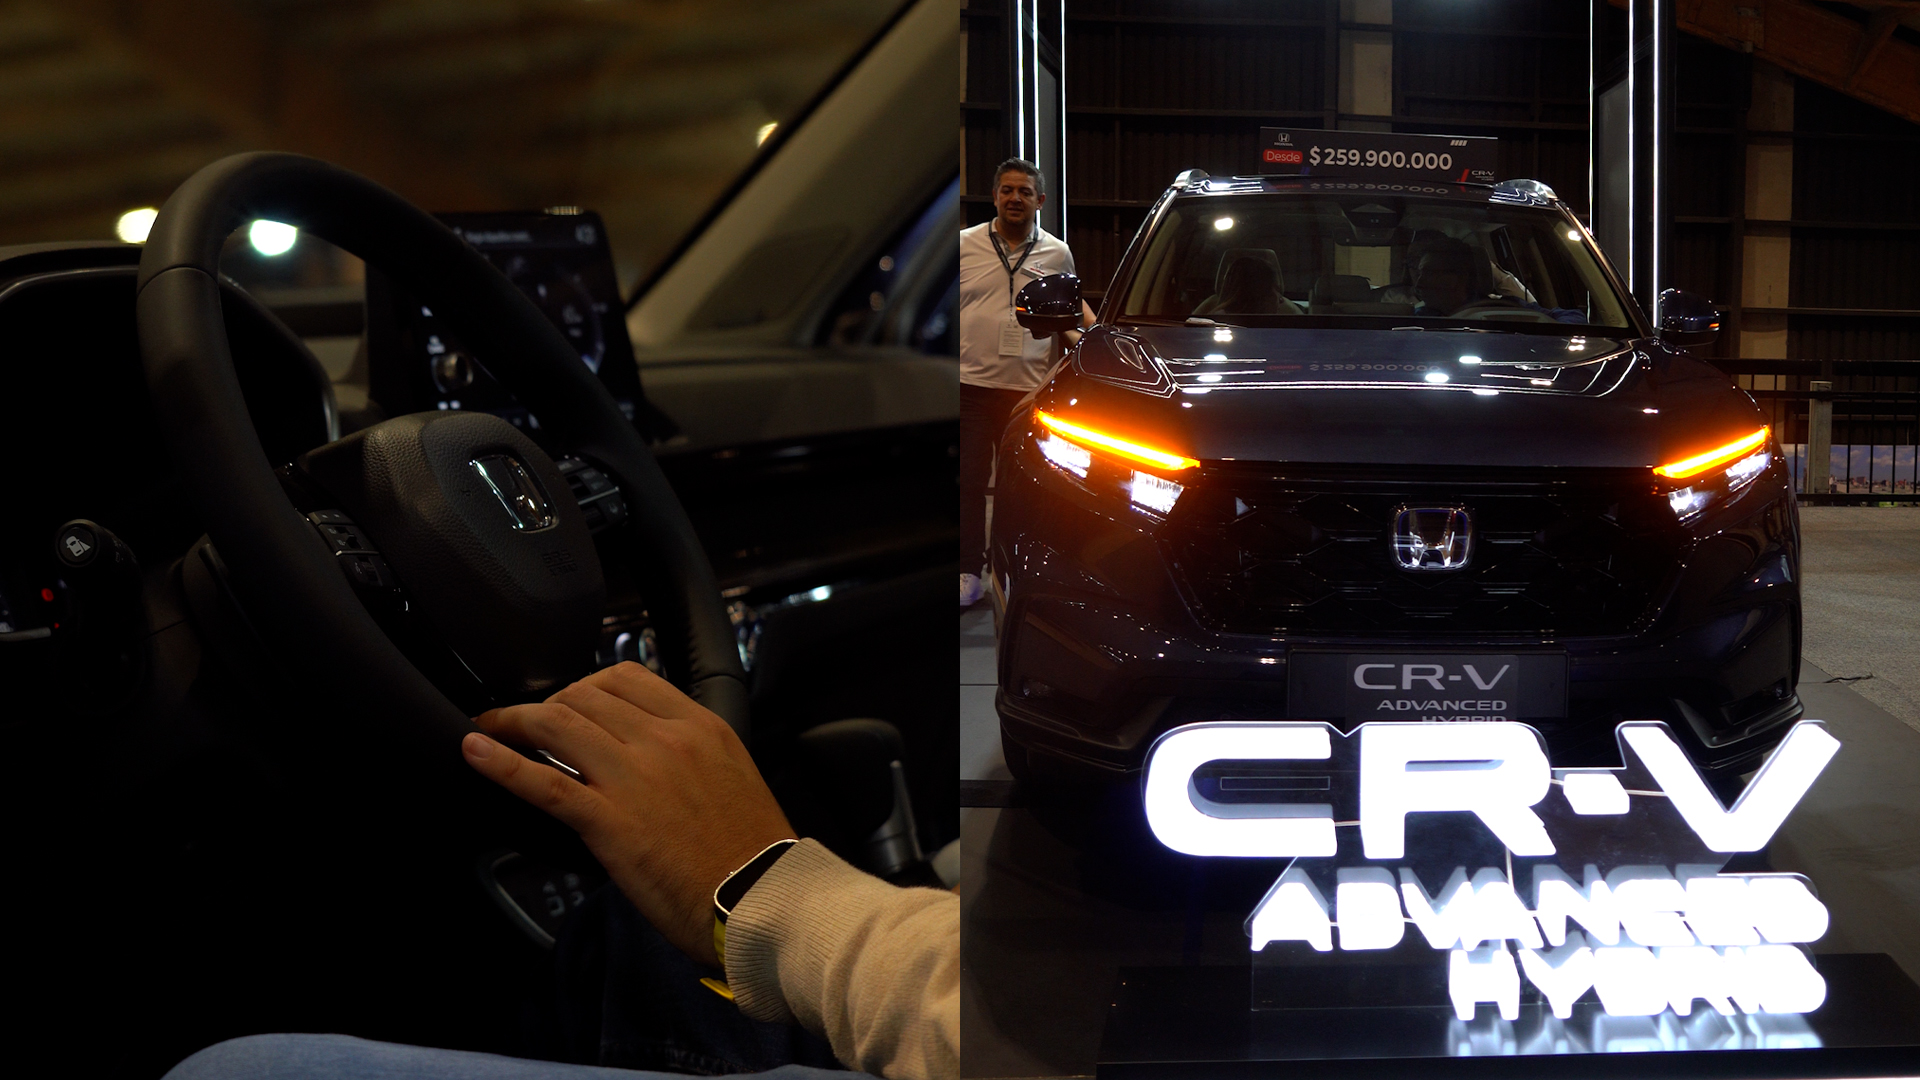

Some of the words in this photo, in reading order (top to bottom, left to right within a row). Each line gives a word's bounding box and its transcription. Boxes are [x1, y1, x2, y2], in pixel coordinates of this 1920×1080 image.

[1266, 150, 1300, 162] Desde
[1354, 663, 1510, 690] CR-V
[1376, 699, 1508, 711] ADVANCED
[1144, 721, 1842, 858] CR-V
[1248, 866, 1829, 951] ADVANCED
[1448, 946, 1828, 1020] HYBRID
